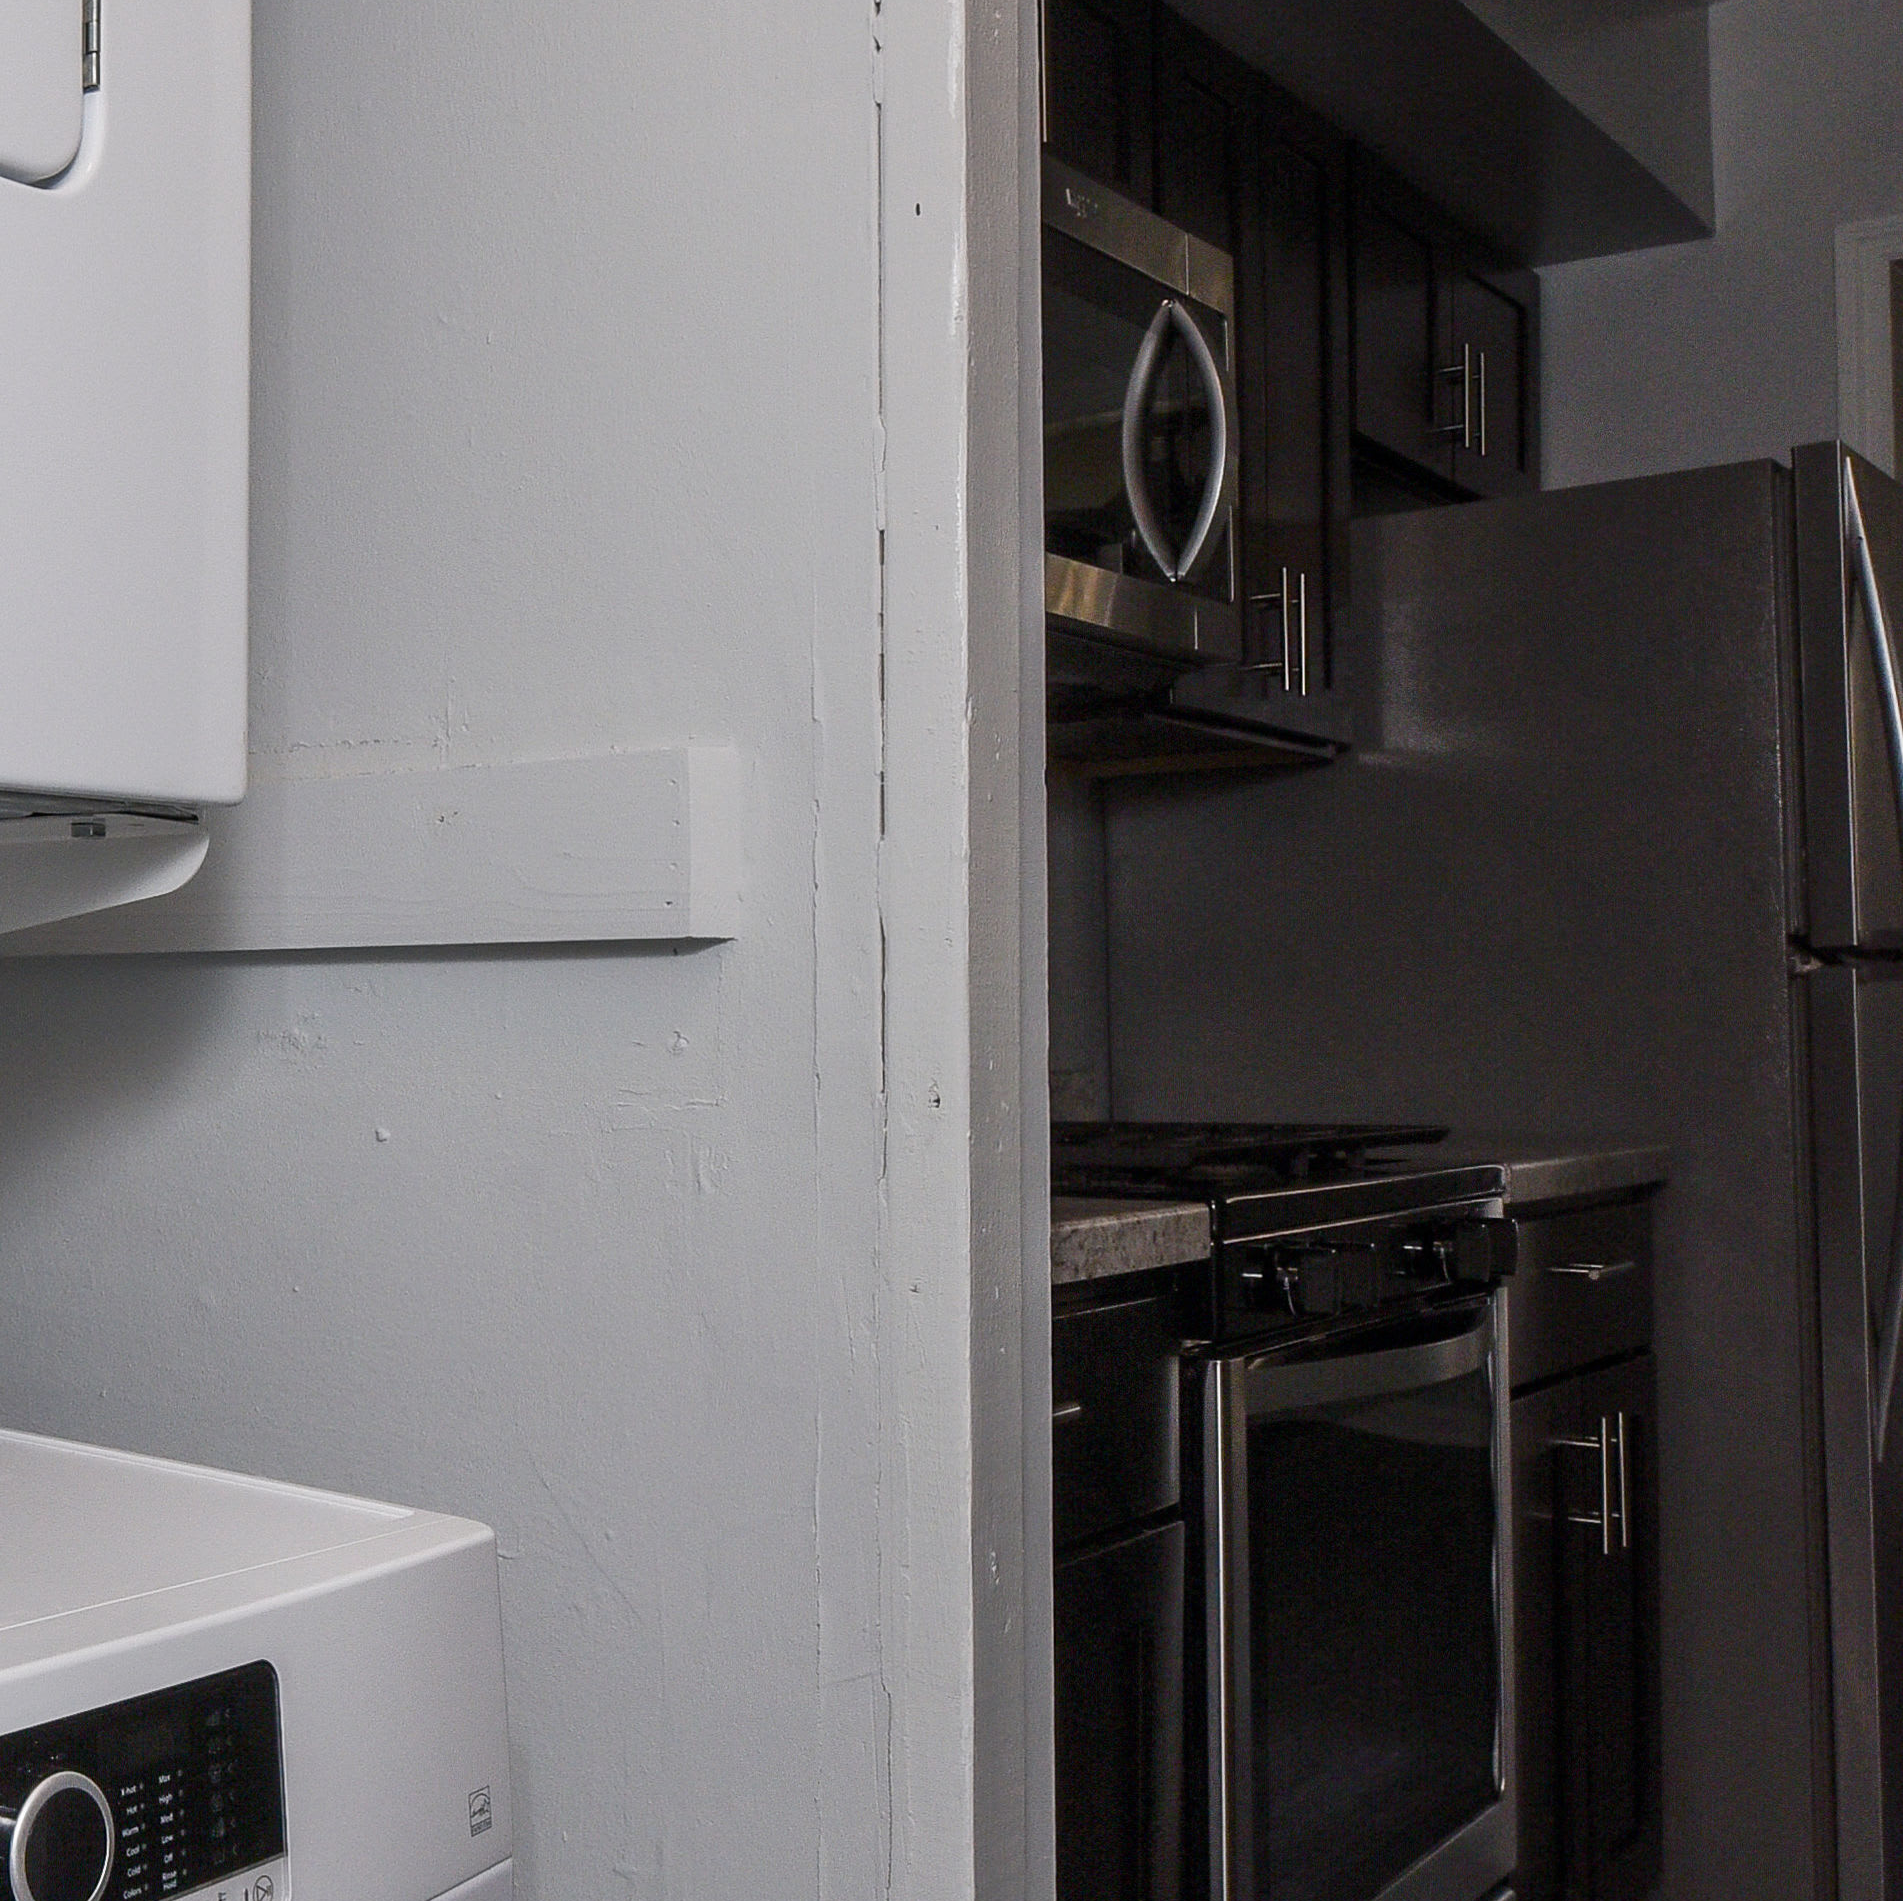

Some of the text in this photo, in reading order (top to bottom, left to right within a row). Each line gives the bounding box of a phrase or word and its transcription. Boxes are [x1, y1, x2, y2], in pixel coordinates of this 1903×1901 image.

[126, 1804, 138, 1815] Hot
[161, 1834, 174, 1845] Low
[126, 1845, 140, 1857] Cool
[127, 1865, 141, 1877] Cold
[123, 1887, 142, 1900] Colors
